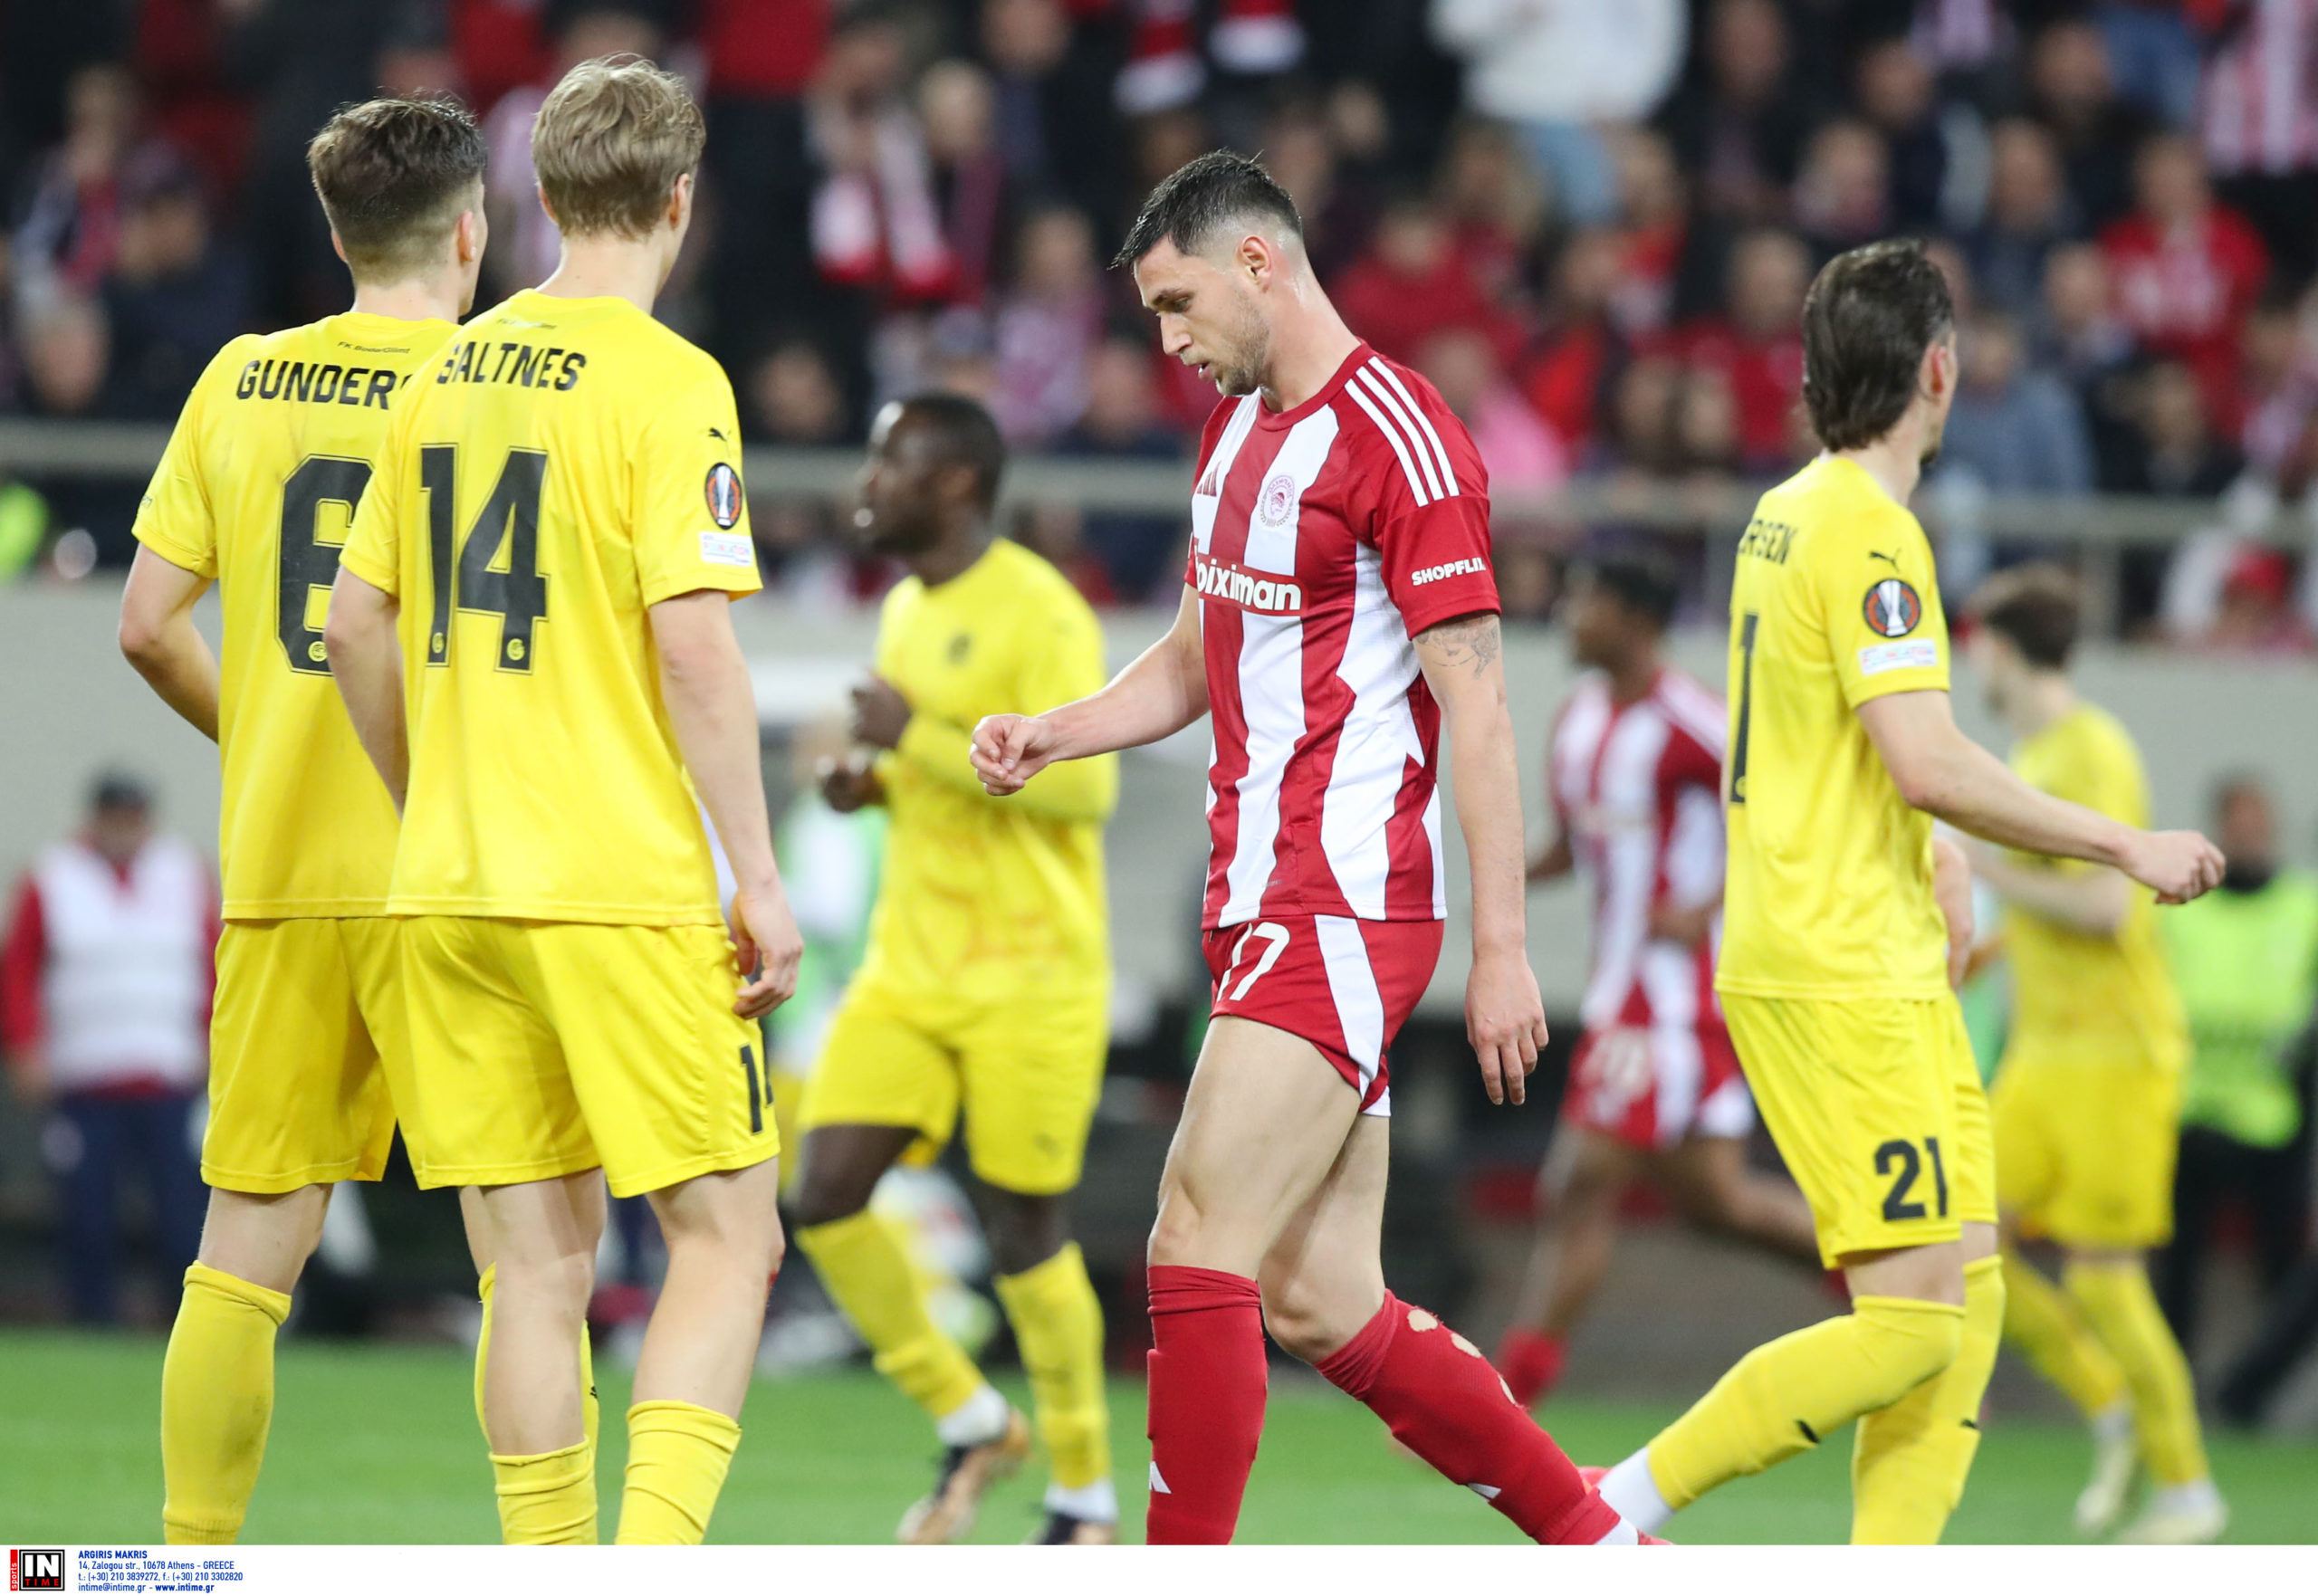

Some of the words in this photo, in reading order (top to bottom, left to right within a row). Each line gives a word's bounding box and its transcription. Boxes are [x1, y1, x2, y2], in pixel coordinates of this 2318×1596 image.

[235, 358, 413, 410] GUNDER
[437, 341, 587, 391] SALTNES
[274, 453, 377, 677] 6
[419, 442, 550, 675] 14
[1194, 546, 1302, 611] oiximan
[1873, 1136, 1949, 1222] 21
